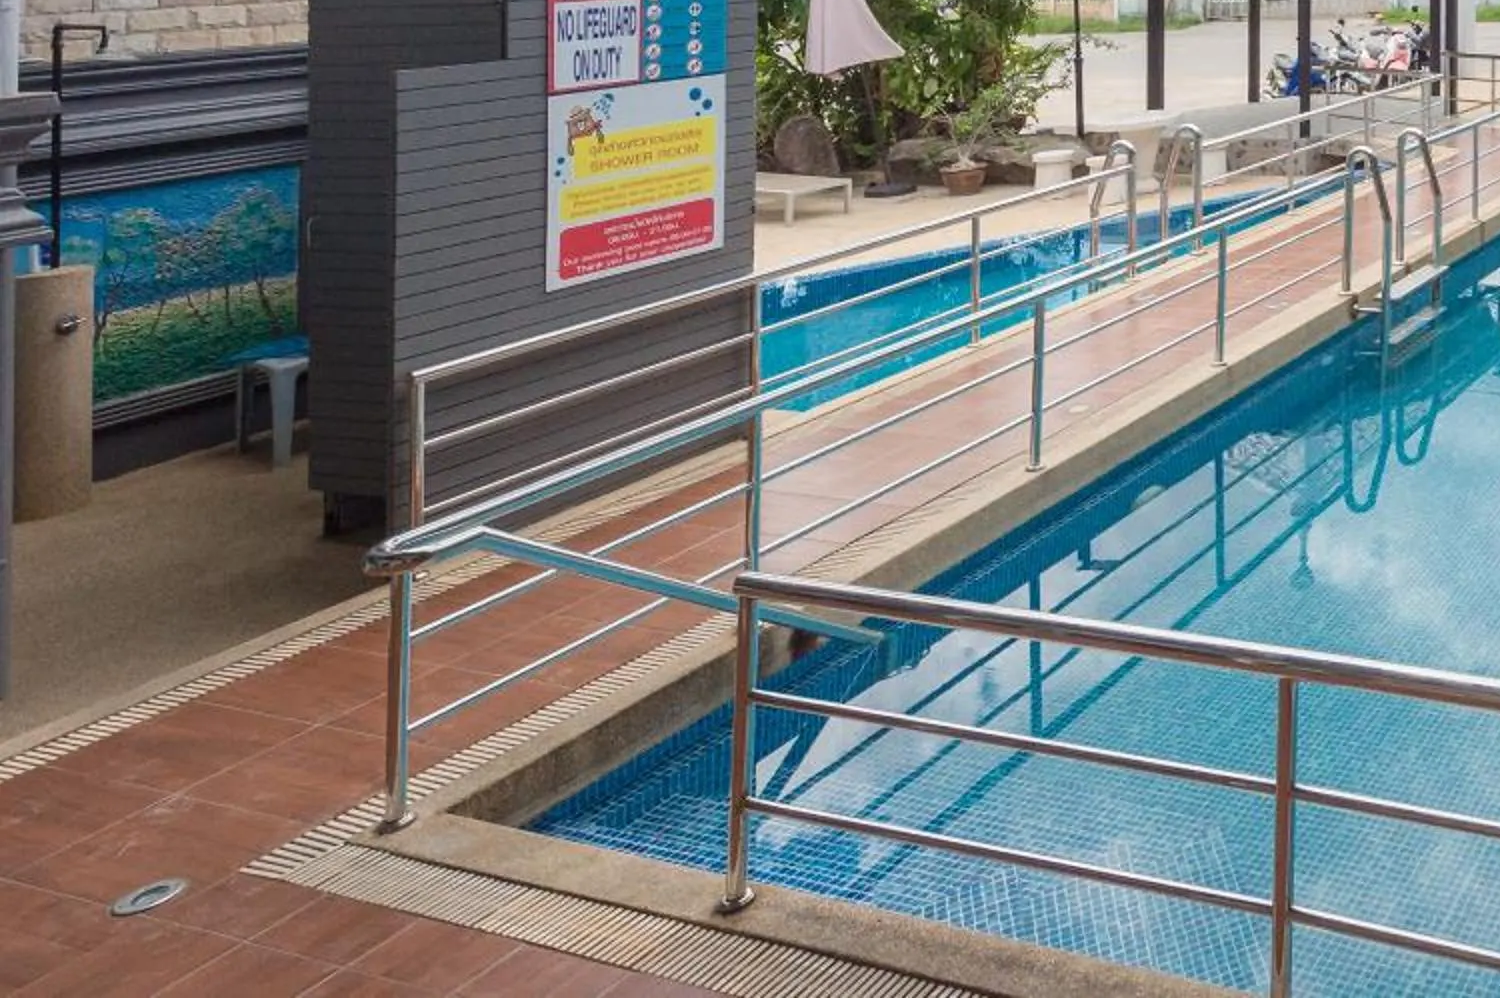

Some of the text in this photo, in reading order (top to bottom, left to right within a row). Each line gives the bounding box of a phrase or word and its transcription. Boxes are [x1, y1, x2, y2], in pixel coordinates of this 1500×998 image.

[557, 5, 637, 42] NO LIFEGUARD
[573, 46, 623, 82] ON DUTY
[590, 143, 700, 173] SHOWER ROOM
